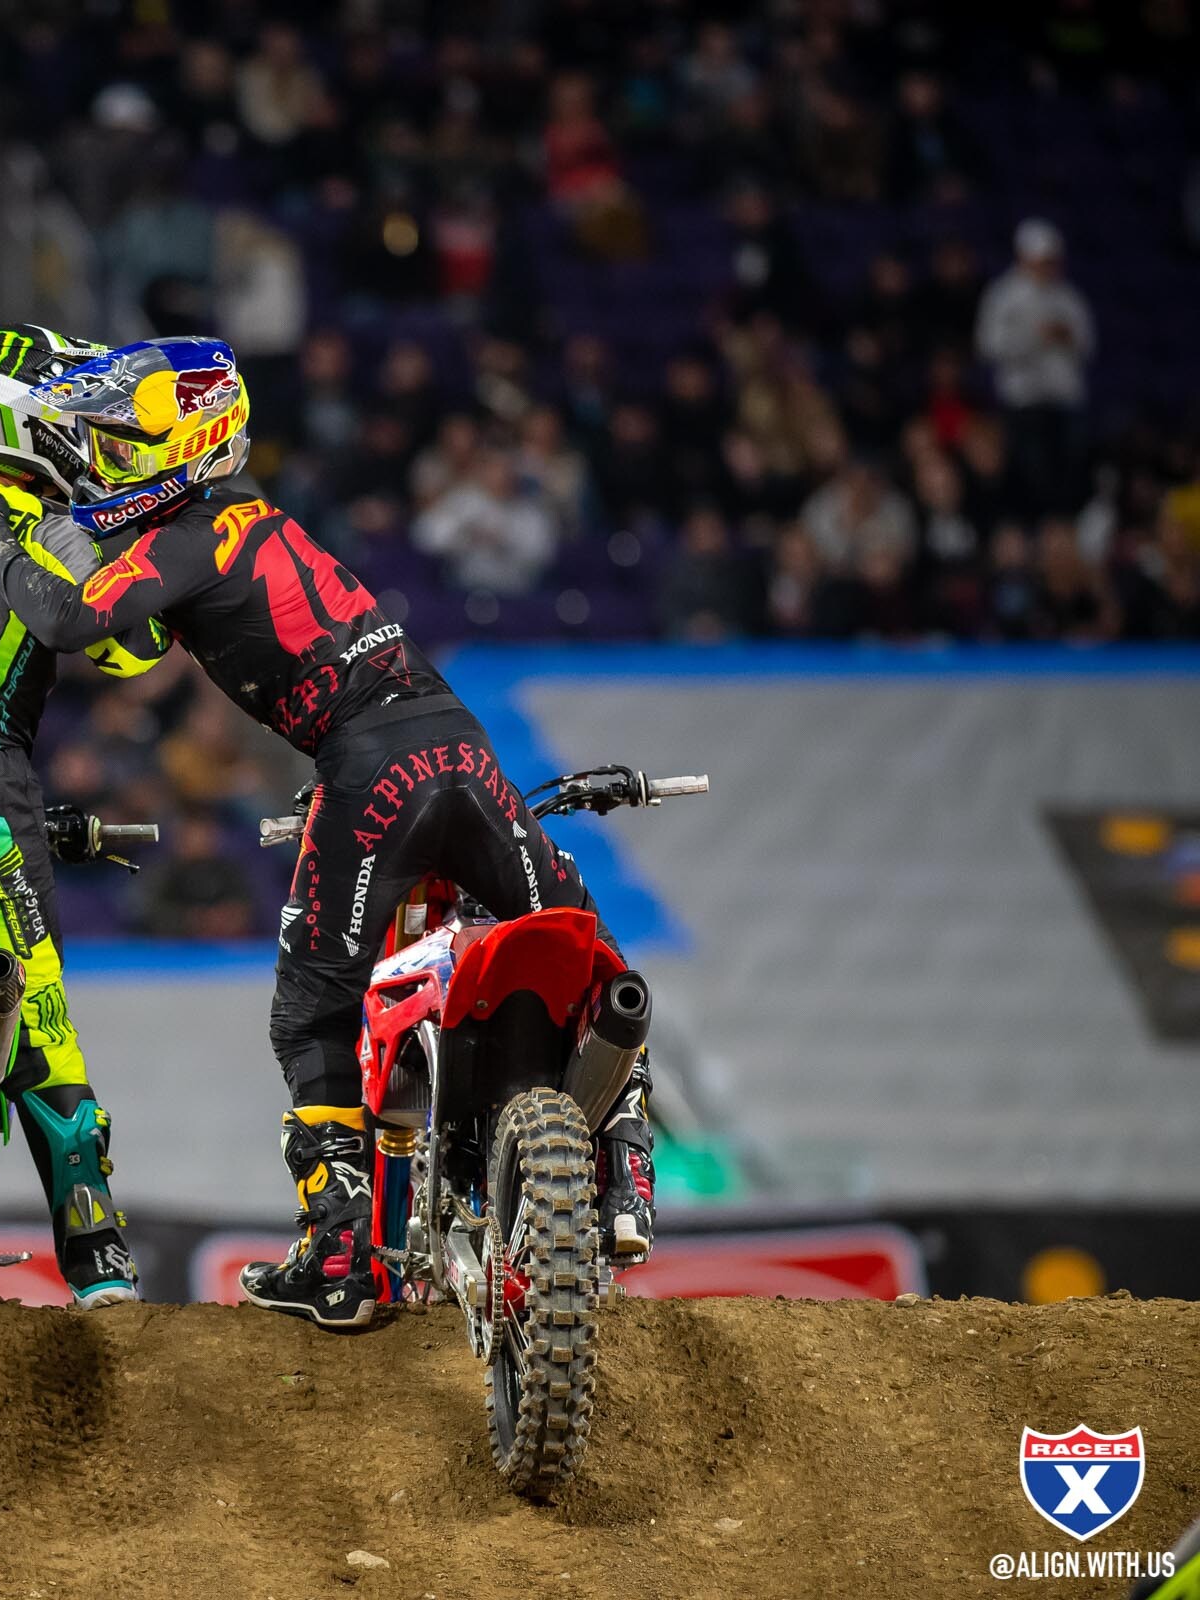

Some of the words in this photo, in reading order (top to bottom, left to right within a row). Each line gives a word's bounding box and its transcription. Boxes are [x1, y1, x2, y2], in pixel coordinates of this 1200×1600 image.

[35, 428, 83, 470] MONSTER
[165, 403, 247, 468] 100%
[353, 741, 519, 853] ALPINESTARS
[12, 867, 47, 941] MONSTER
[349, 853, 377, 936] HONDA
